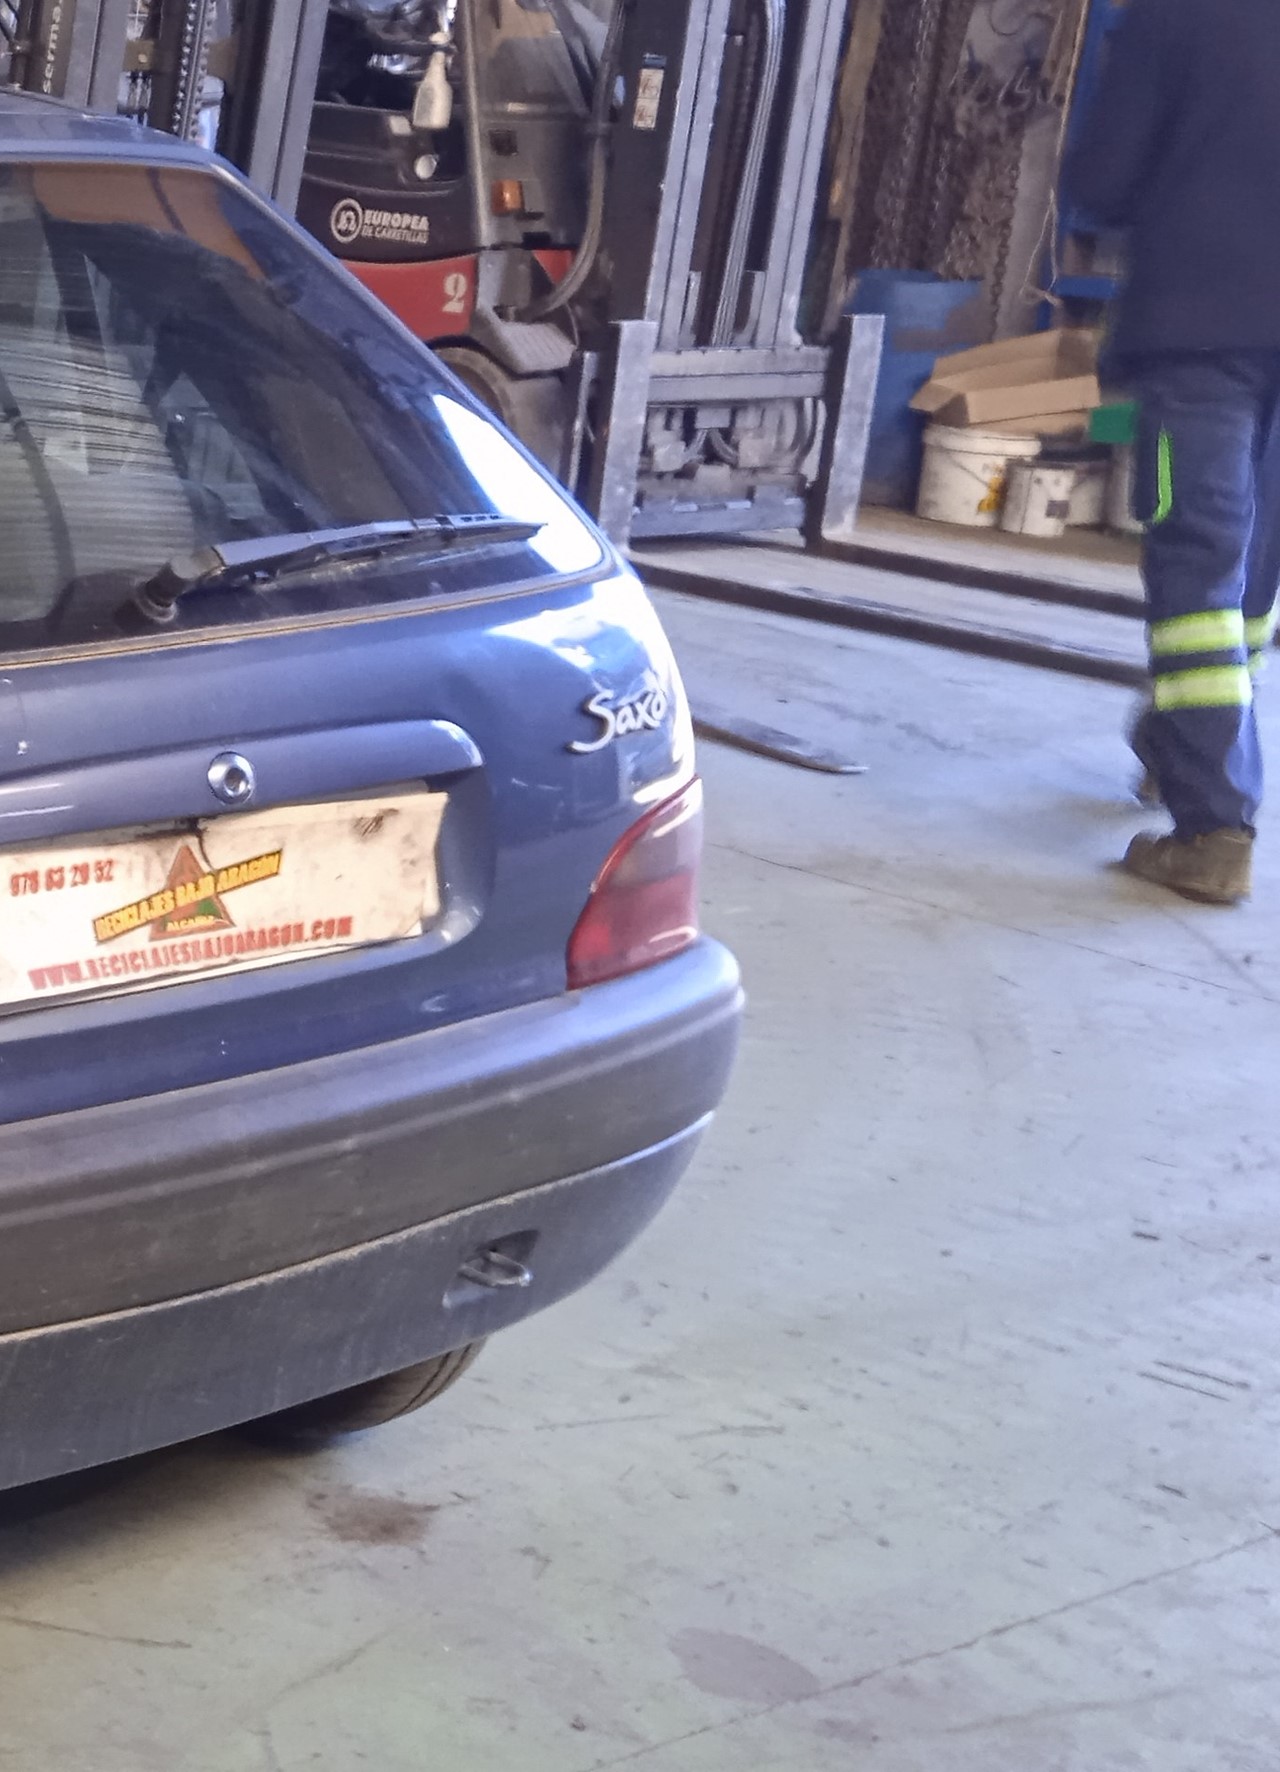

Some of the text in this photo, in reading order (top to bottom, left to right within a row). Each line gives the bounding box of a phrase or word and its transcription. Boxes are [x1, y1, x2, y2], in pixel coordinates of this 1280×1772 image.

[43, 0, 63, 94] serma
[364, 209, 429, 231] EUROPEA
[442, 272, 468, 314] 2
[571, 689, 667, 752] Saxo
